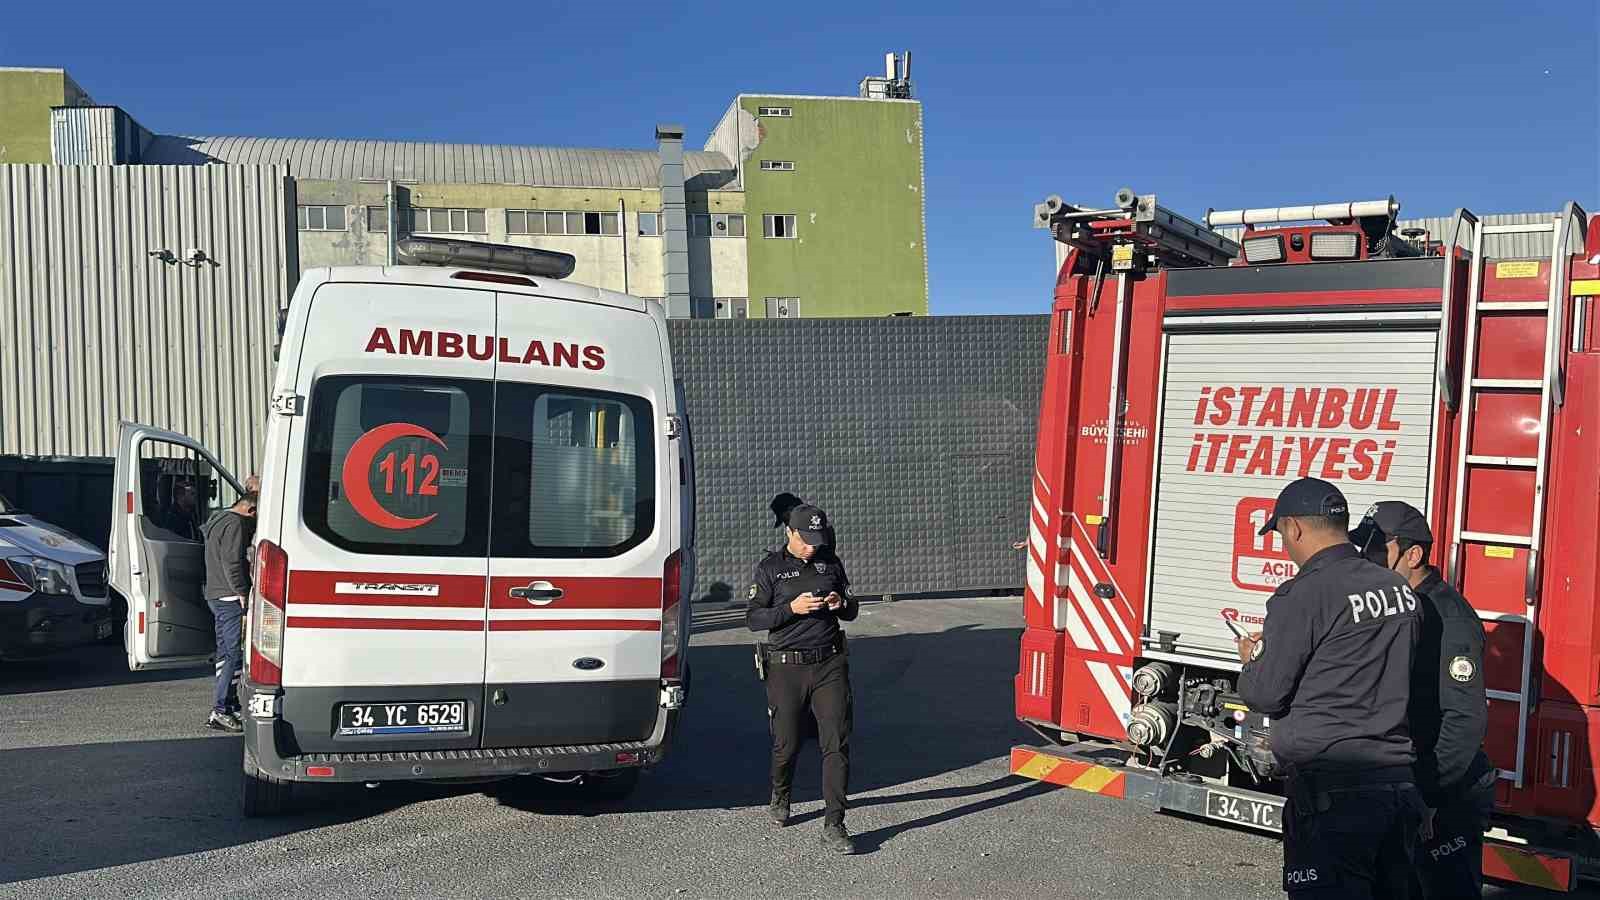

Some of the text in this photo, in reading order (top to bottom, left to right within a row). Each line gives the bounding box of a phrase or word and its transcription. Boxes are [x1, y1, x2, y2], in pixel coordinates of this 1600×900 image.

[366, 327, 606, 370] AMBULANS
[379, 452, 440, 495] 112
[353, 583, 435, 591] TRANSIT
[351, 704, 461, 726] 34 YC 6529
[1218, 796, 1274, 826] 34 YC
